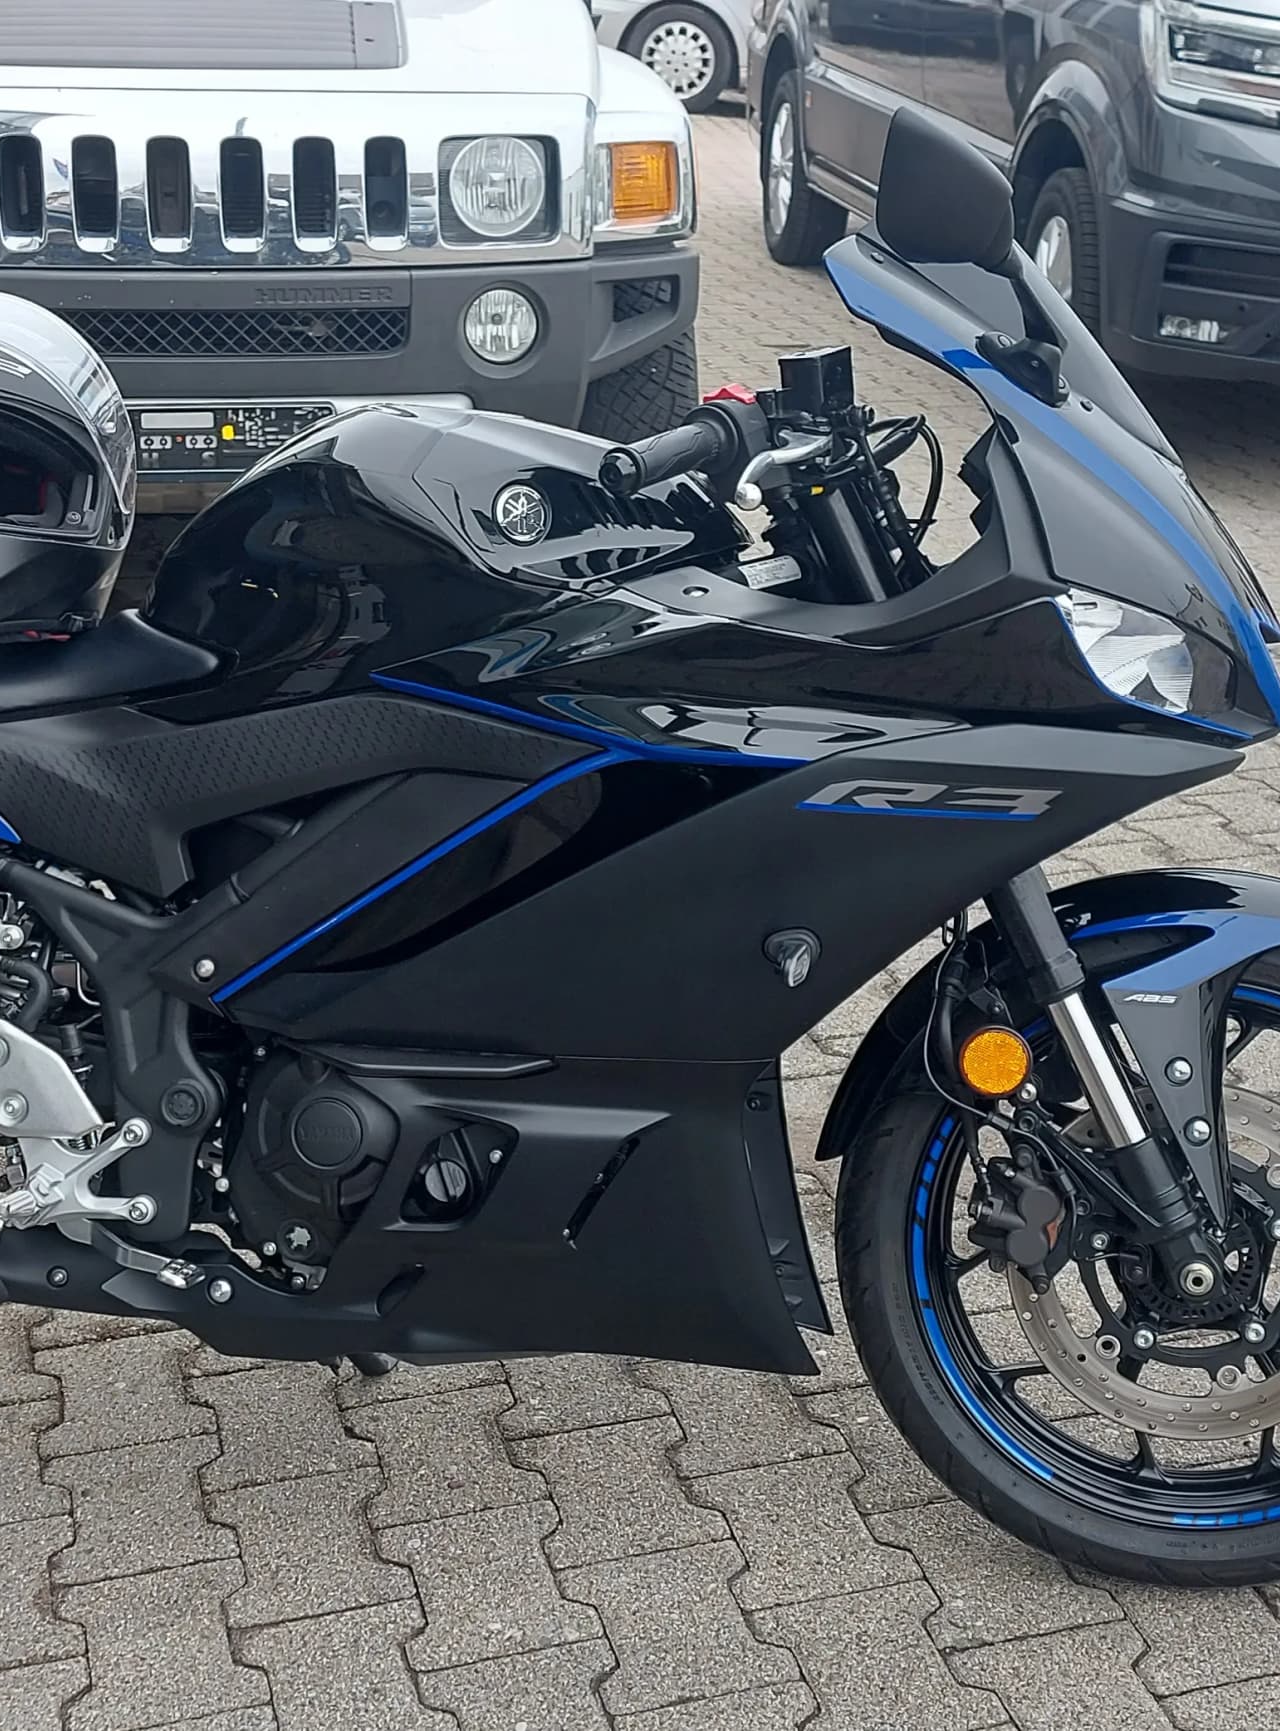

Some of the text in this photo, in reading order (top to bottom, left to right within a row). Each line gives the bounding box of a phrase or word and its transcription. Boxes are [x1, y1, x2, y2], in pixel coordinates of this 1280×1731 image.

[256, 286, 393, 304] HUMMER
[802, 779, 1064, 815] R3
[1123, 993, 1178, 1004] ABS
